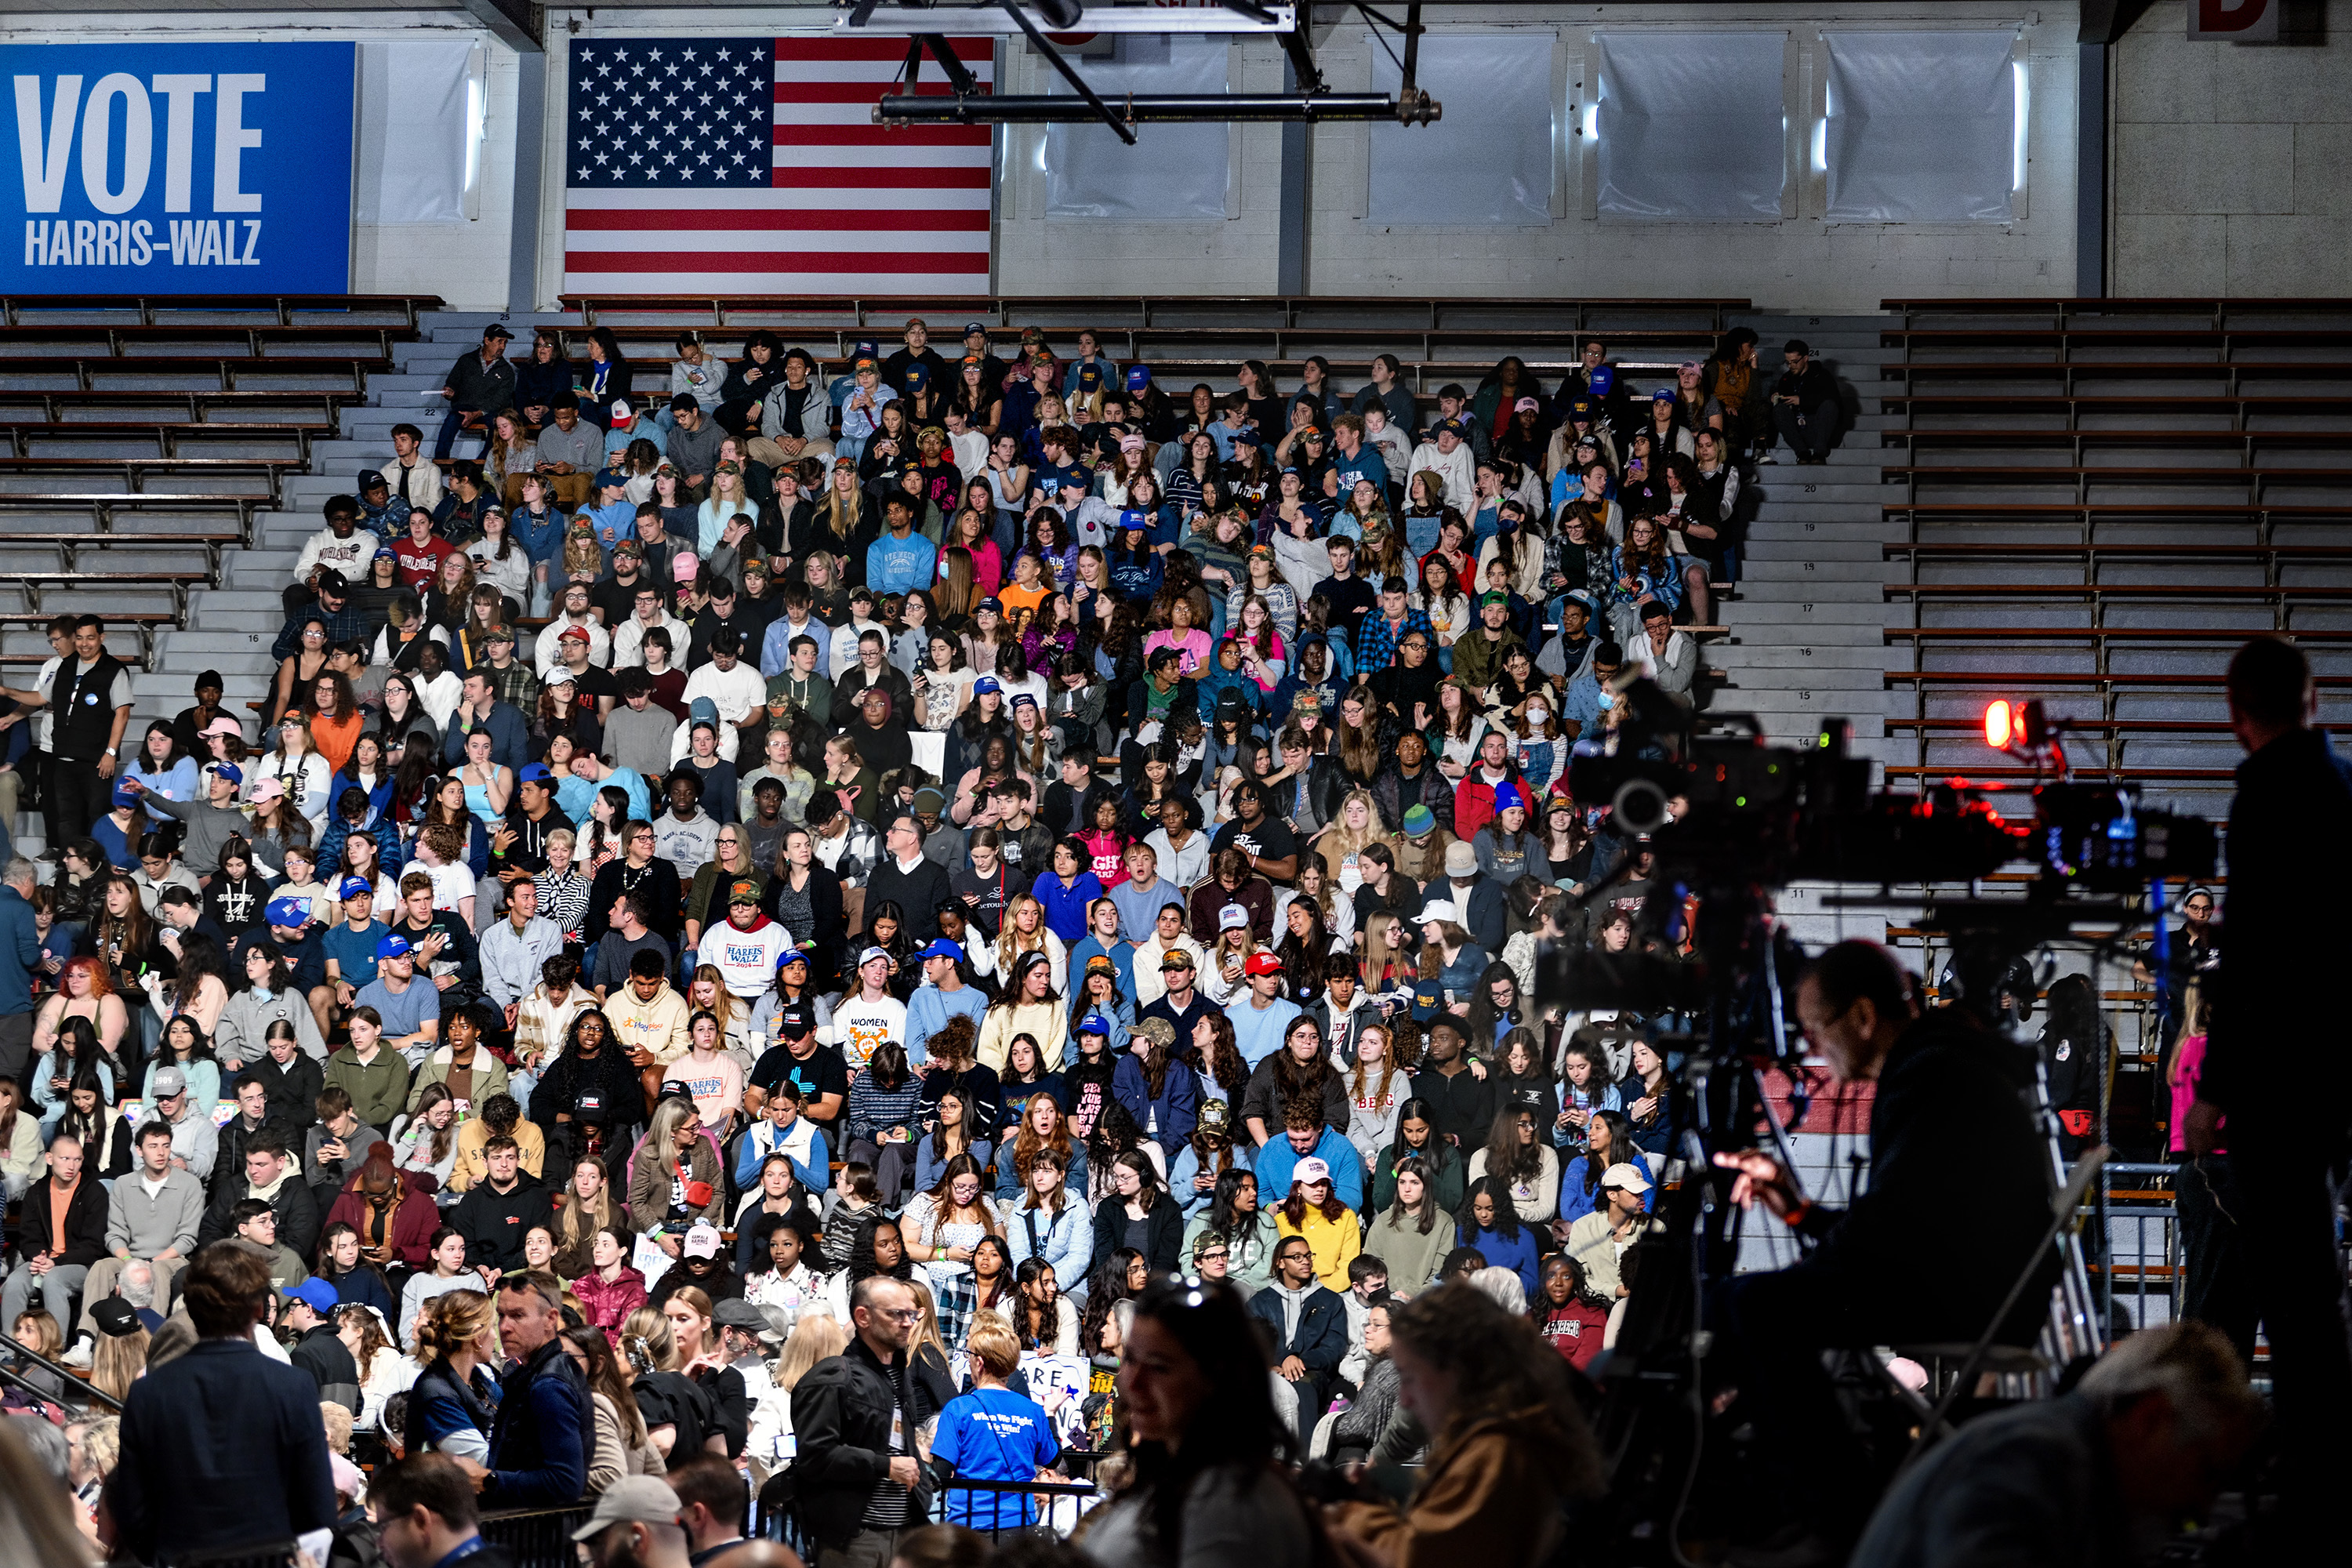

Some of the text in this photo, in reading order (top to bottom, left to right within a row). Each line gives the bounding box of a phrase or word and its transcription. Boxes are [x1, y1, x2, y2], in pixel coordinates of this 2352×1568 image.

[13, 72, 267, 215] VOTE
[24, 219, 261, 267] HARRIS-WALZ
[1802, 604, 1813, 612] 17
[1800, 648, 1812, 656] 16
[1798, 691, 1810, 700] 15
[1798, 739, 1809, 747] 14
[727, 946, 763, 956] HARRIS
[731, 954, 759, 964] WALZ
[851, 1018, 887, 1027] WOMEN
[155, 1076, 173, 1085] 1909
[1790, 1137, 1798, 1146] 7
[972, 1412, 1034, 1427] Whn We Fight,
[987, 1422, 1000, 1432] We
[1001, 1423, 1021, 1433] Win!
